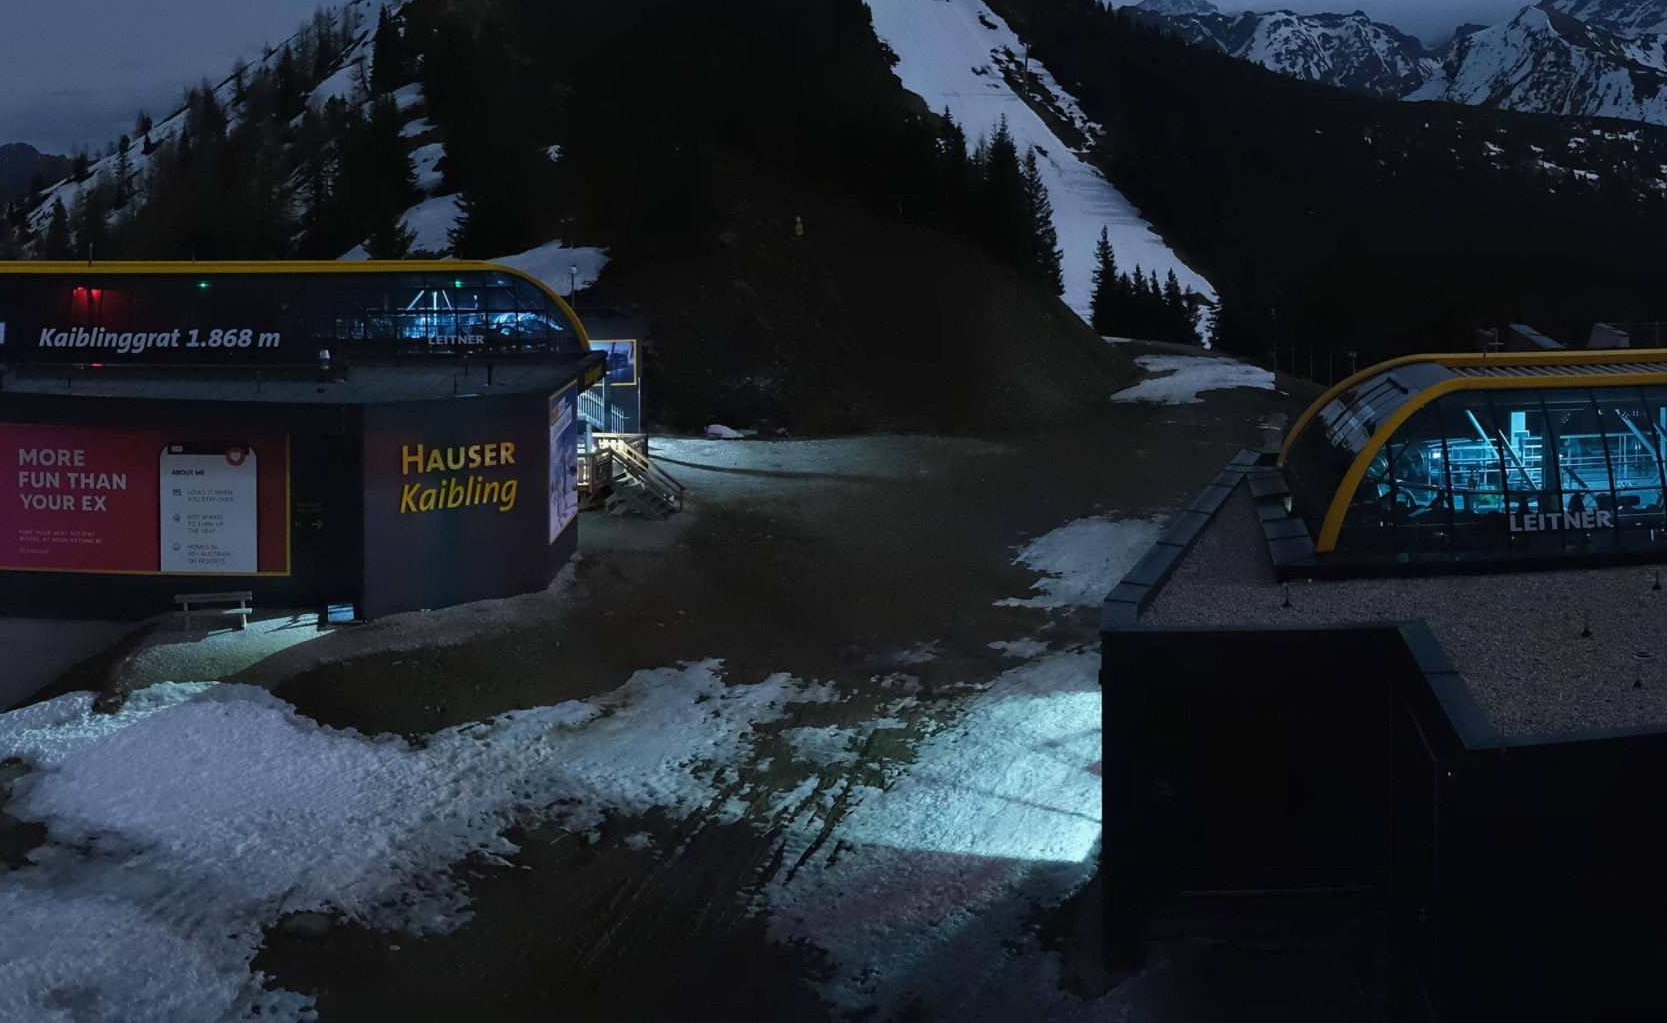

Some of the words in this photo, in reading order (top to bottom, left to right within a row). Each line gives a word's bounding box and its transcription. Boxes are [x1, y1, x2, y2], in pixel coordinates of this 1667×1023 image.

[38, 327, 180, 354] Kaiblinggrat
[186, 328, 253, 348] 1.868
[258, 332, 280, 347] m
[428, 335, 484, 345] LEITNER
[18, 448, 85, 467] MORE
[401, 441, 517, 475] HAUSER
[18, 471, 60, 489] FUN
[66, 472, 127, 490] THAN
[19, 493, 75, 511] YOUR
[81, 495, 107, 512] EX
[400, 475, 518, 514] Kaibling
[1509, 510, 1615, 532] LEITNER
